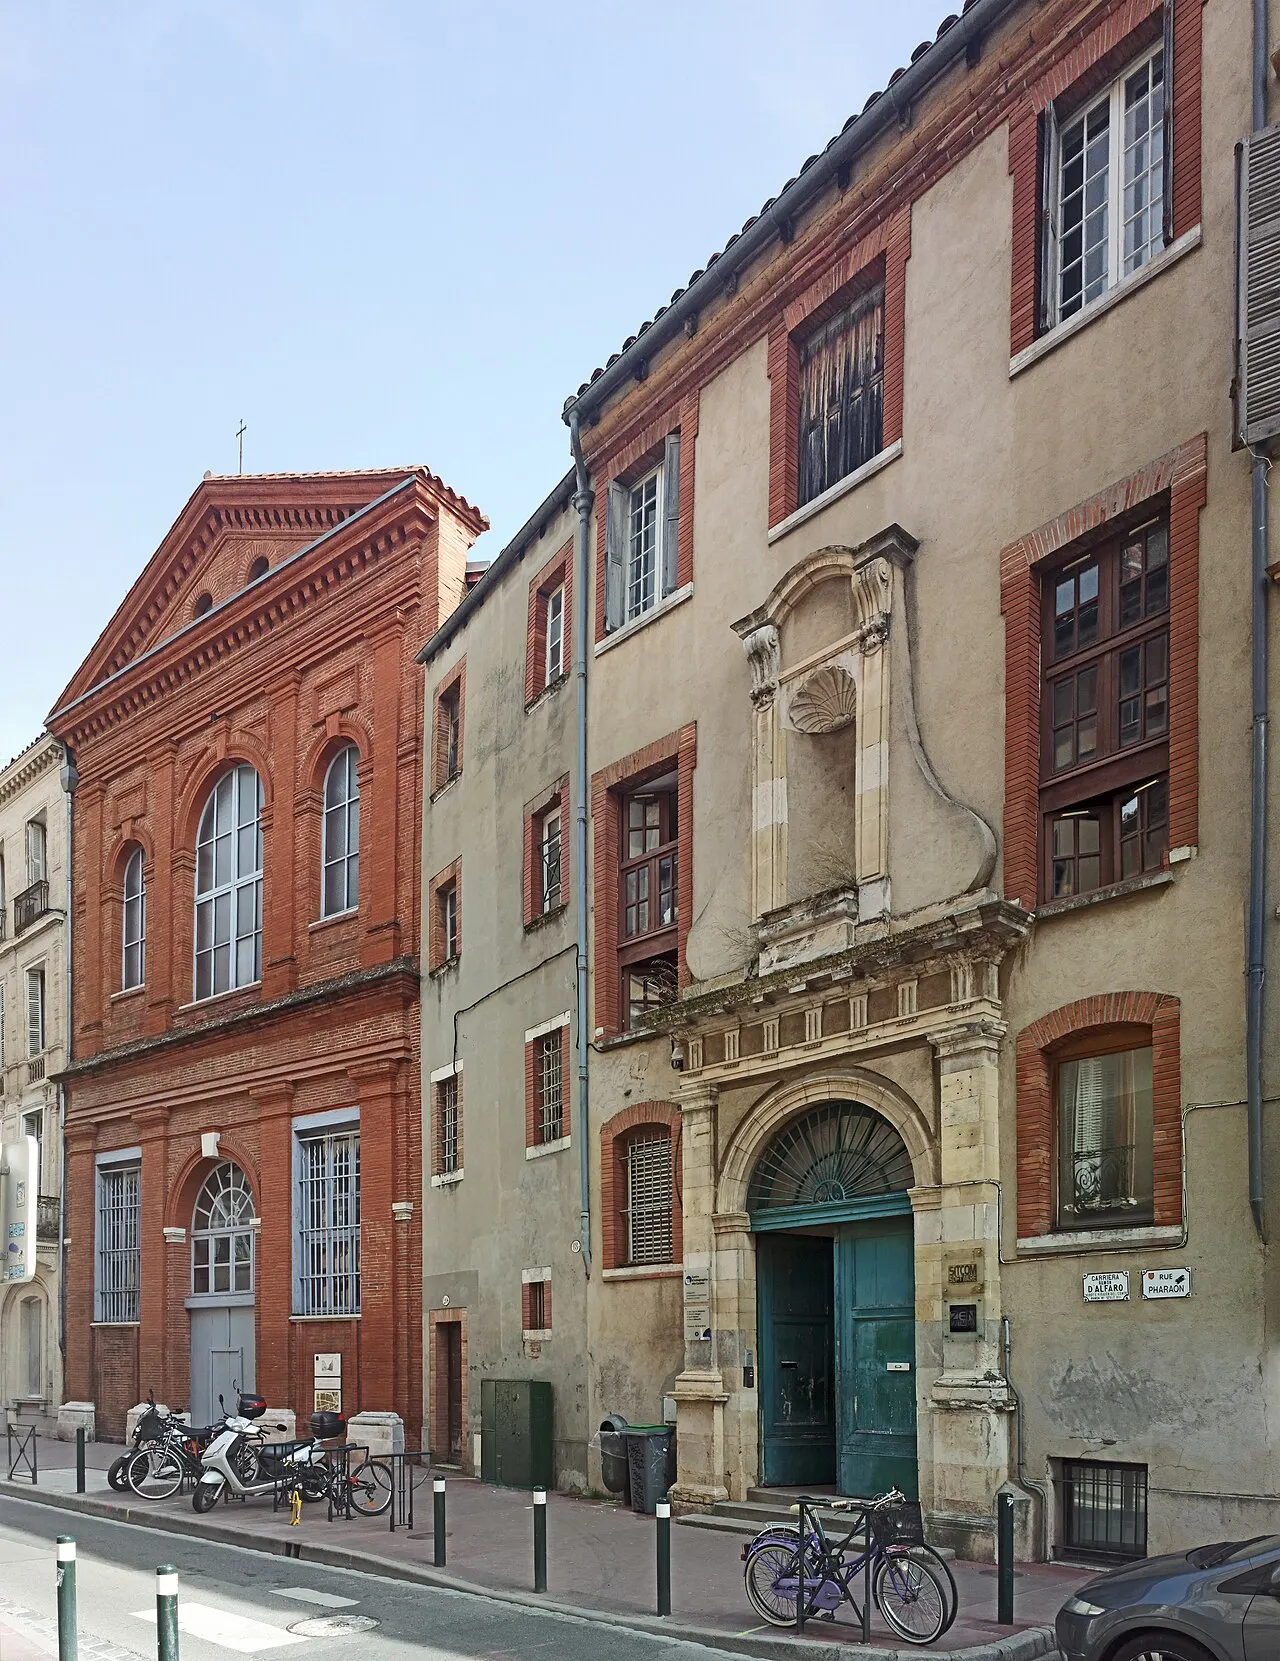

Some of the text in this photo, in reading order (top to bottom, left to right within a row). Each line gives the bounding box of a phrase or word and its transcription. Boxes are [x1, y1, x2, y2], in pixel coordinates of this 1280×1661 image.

[948, 1264, 977, 1276] SITCOM
[1087, 1283, 1124, 1293] D'ALFARO
[1148, 1284, 1185, 1294] PHARAON
[950, 1311, 975, 1321] ZEN
